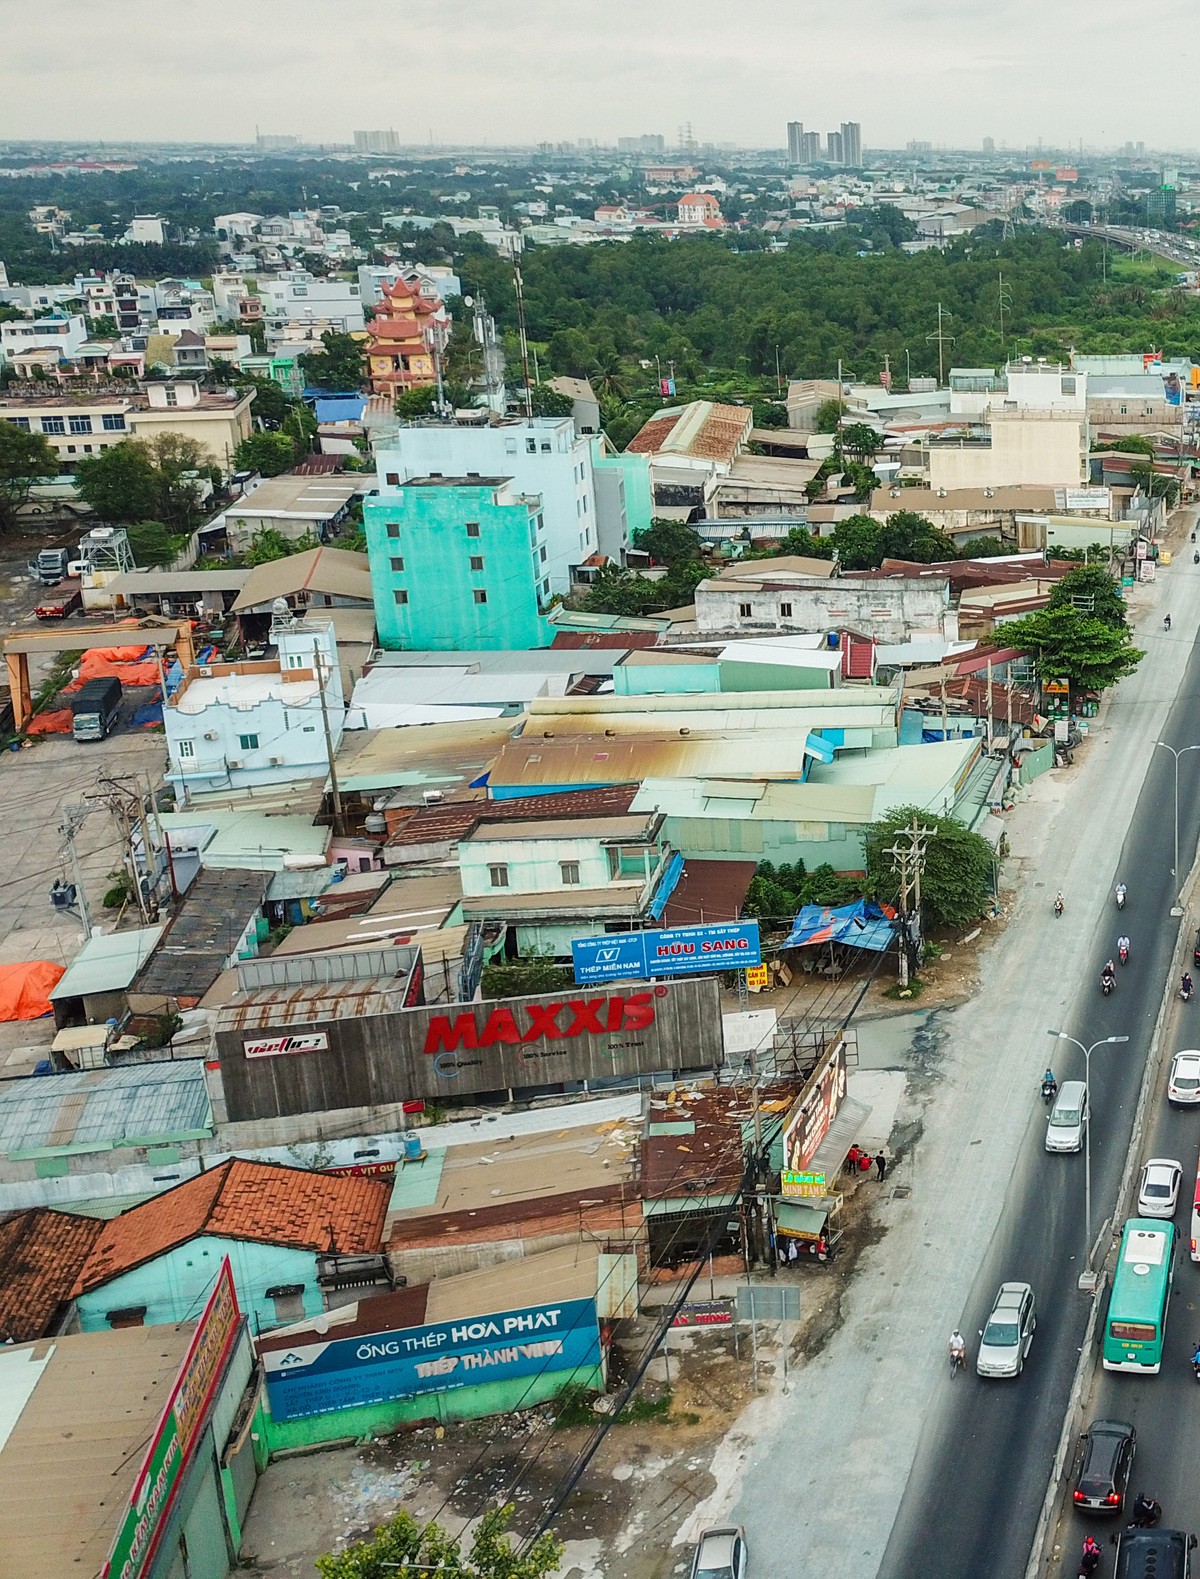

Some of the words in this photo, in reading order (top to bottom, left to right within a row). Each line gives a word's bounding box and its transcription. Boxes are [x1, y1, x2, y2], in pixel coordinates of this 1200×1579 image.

[701, 938, 748, 952] SANG
[580, 966, 602, 974] THÉP
[623, 961, 640, 969] NAM
[423, 992, 655, 1054] MAXXIS
[607, 1042, 624, 1050] 100%
[626, 1040, 645, 1048] Trust
[540, 1050, 567, 1058] Service
[457, 1059, 483, 1068] Quality
[783, 1185, 802, 1194] MINH
[695, 1311, 732, 1325] PHONG
[356, 1342, 399, 1361] ỐNG
[402, 1332, 447, 1353] THÉP
[503, 1309, 561, 1334] PHÁT
[414, 1355, 459, 1379] THÉP
[460, 1349, 519, 1370] THÀNH
[519, 1339, 563, 1360] VINH
